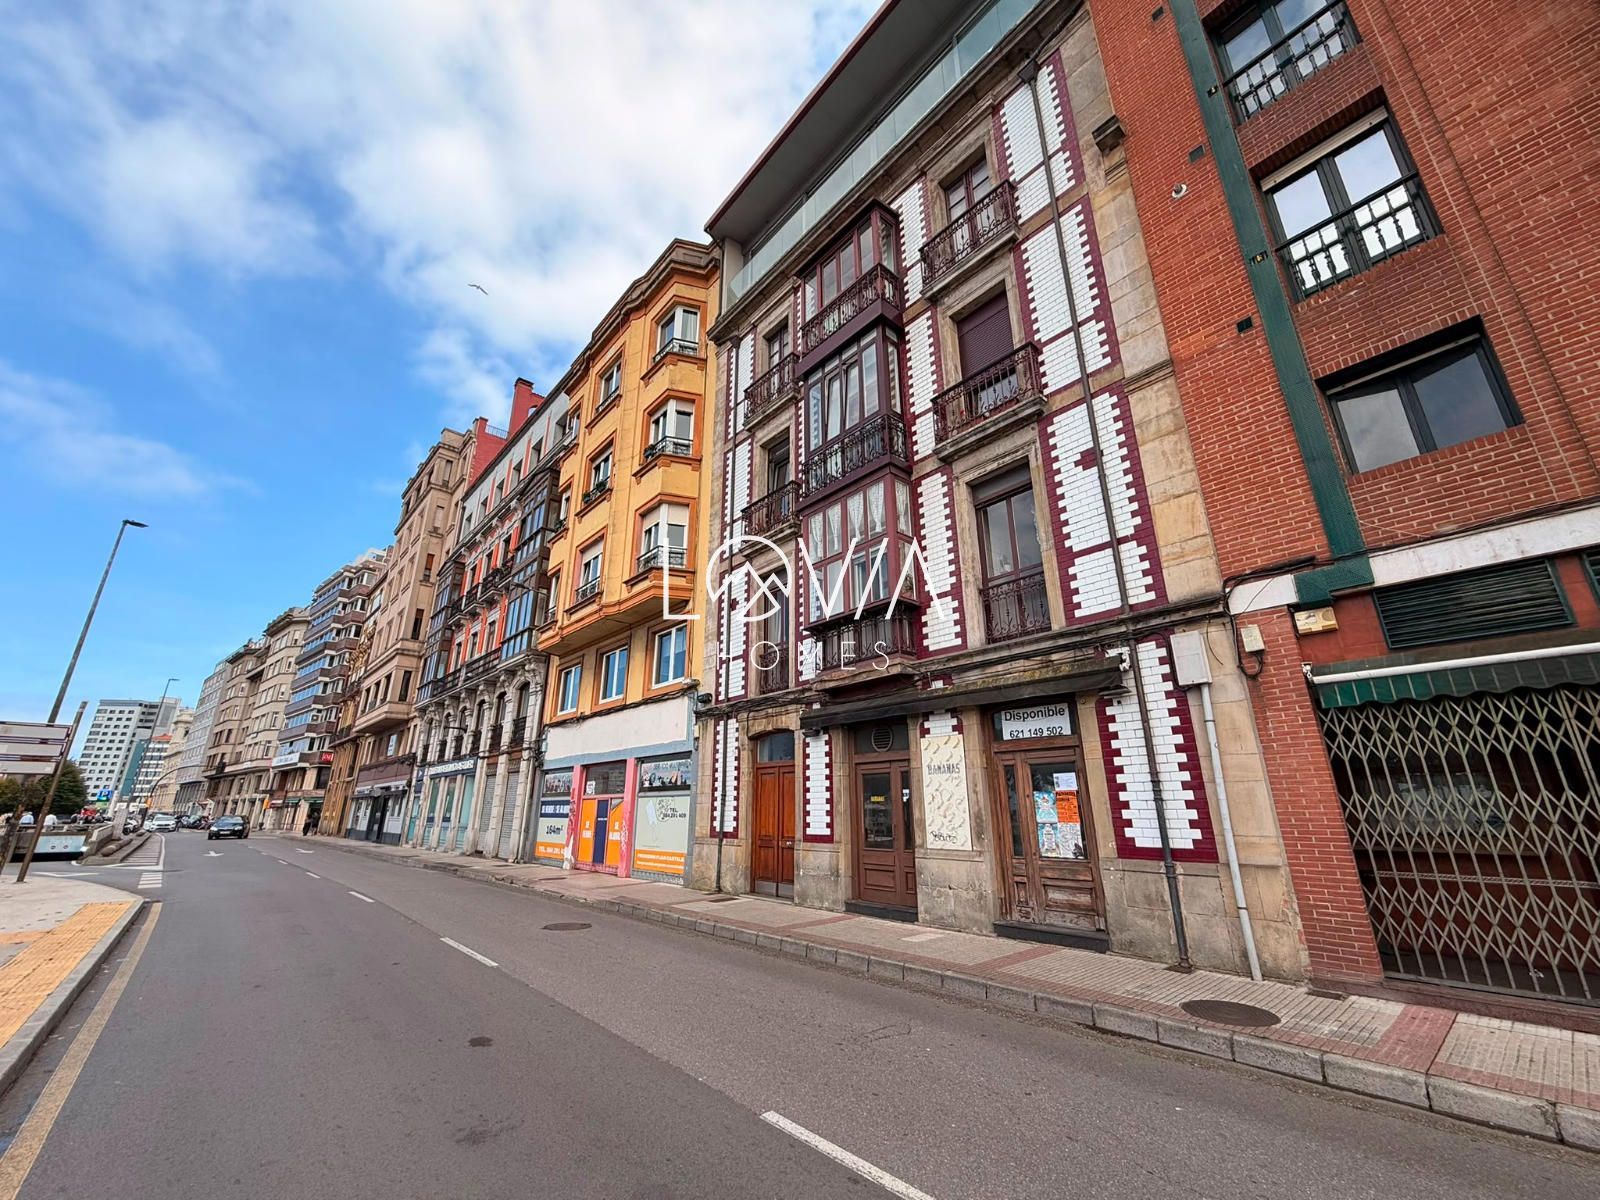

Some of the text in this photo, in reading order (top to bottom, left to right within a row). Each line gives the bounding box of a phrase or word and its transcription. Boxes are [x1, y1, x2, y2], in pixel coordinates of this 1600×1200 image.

[1004, 705, 1065, 722] Disponible
[1009, 726, 1063, 738] 621 149 502
[927, 763, 961, 775] BANANAS
